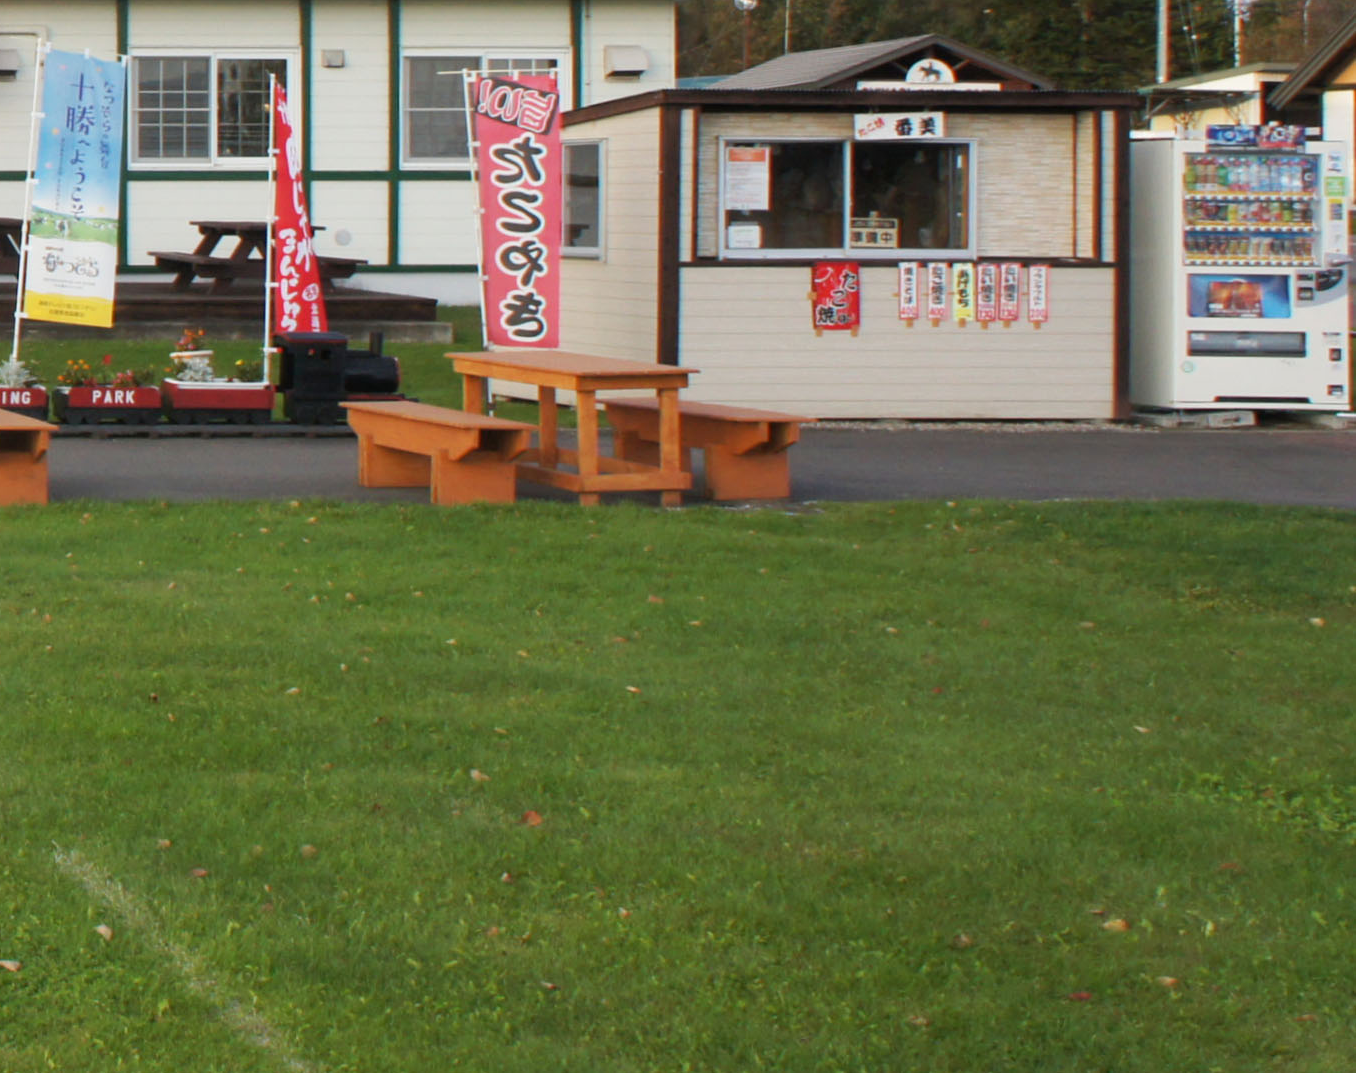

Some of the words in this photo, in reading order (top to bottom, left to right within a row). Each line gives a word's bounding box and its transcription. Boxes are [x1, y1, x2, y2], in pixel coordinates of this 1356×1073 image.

[65, 72, 96, 221] 十勝へようこそ
[92, 390, 136, 404] PARK
